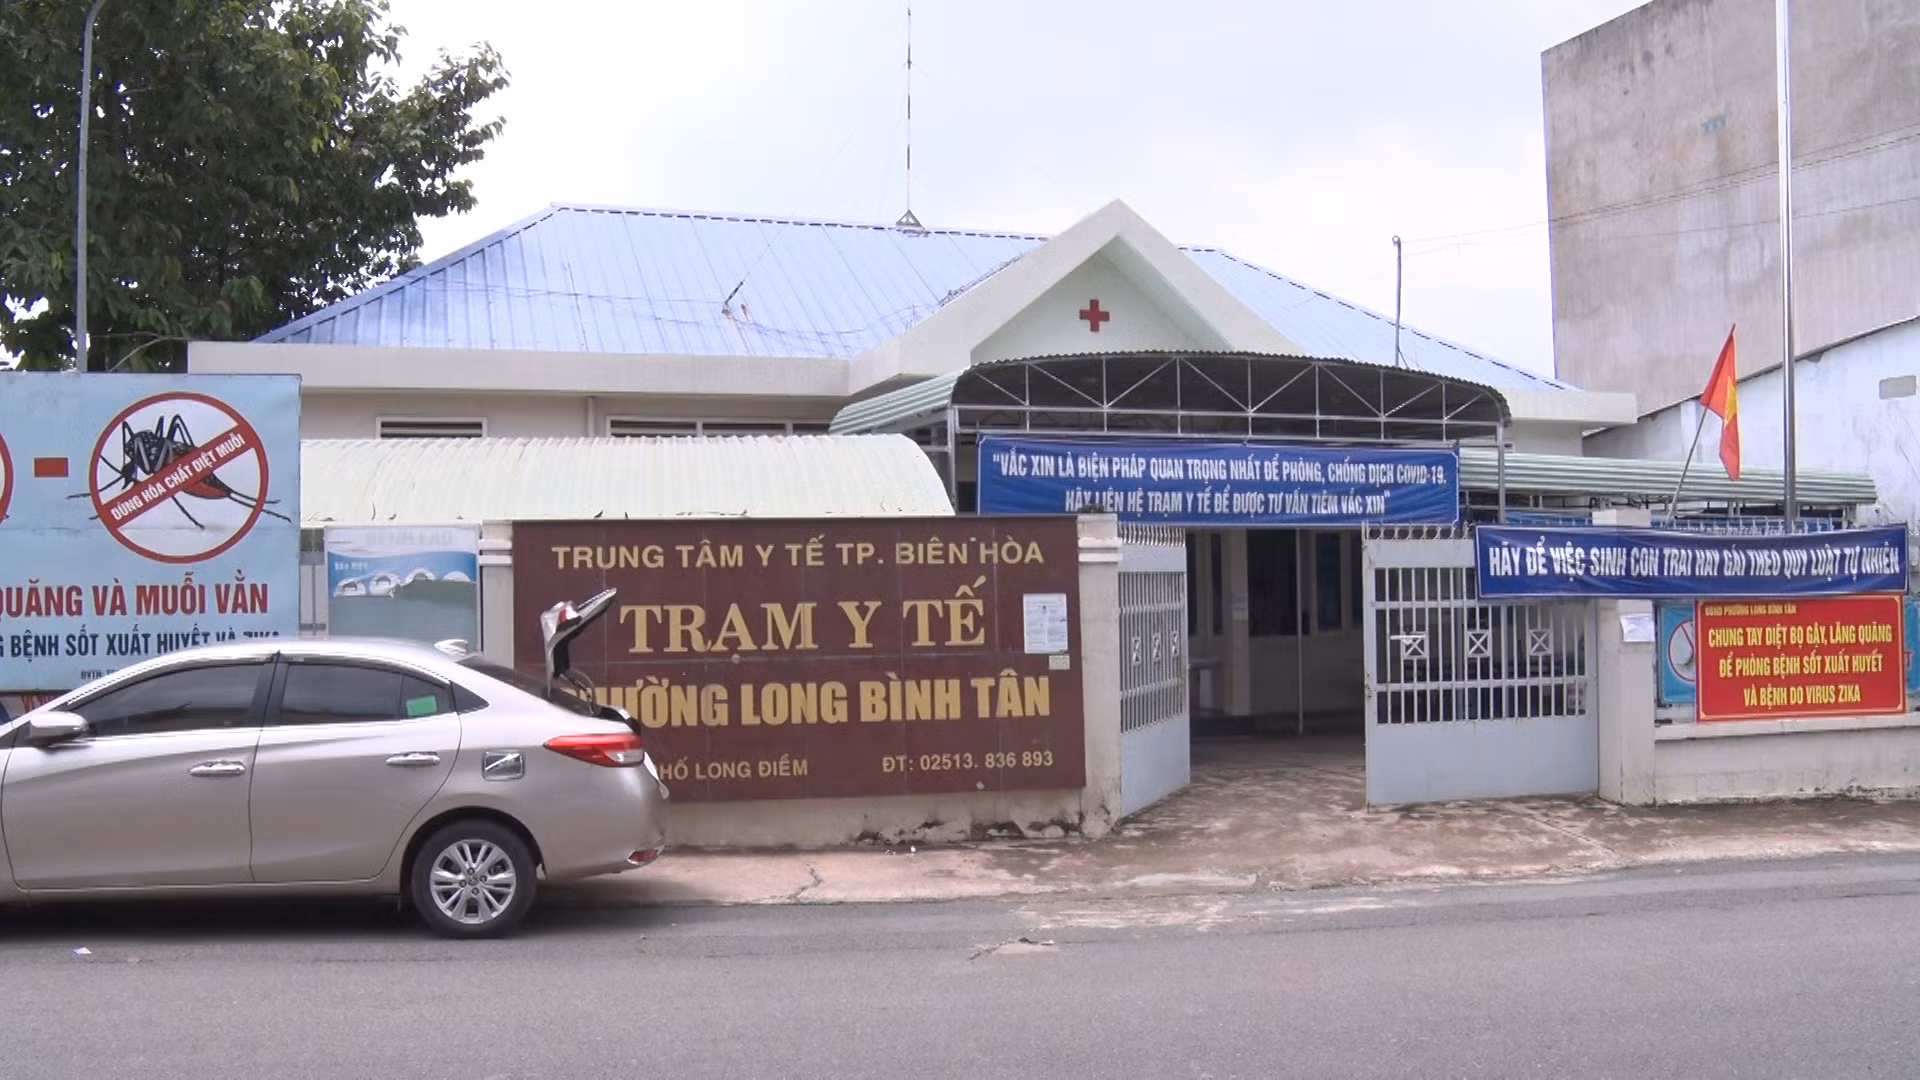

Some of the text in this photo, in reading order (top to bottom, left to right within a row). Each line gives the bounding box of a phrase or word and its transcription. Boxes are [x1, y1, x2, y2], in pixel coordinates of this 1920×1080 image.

[165, 464, 194, 488] CHẤT
[1031, 455, 1054, 477] XIN
[1058, 452, 1074, 478] LÀ
[1078, 452, 1109, 483] BIỆN
[1112, 453, 1147, 479] PHÁP
[1150, 458, 1184, 480] QUAN
[1186, 459, 1227, 483] TRỌNG
[1229, 453, 1261, 480] NHẤT
[1263, 453, 1280, 481] ĐỂ
[1282, 457, 1325, 484] PHÒNG,
[1327, 456, 1366, 483] CHỐNG
[1369, 463, 1394, 488] DỊCH
[1396, 464, 1447, 484] COVID-19.
[1127, 488, 1144, 517] HỆ
[1147, 491, 1183, 517] TRẠM
[1186, 492, 1195, 513] Y
[1196, 485, 1212, 513] TẾ
[1213, 483, 1231, 513] ĐỂ
[1232, 491, 1266, 518] ĐƯỢC
[1267, 491, 1284, 514] TƯ
[1285, 487, 1308, 514] VẤN
[1311, 489, 1338, 515] TIÊM
[551, 534, 1045, 570] TRUNG TÂM Y TẾ TP. BIÊN HÒA
[1488, 535, 1900, 582] HÃY ĐỂ VIỆC SINH CON TRAI HAY GÁI THEO QUY LUẬT TỰ NHIÊN
[0, 569, 268, 620] UĂNG VÀ MUỖI VẰN
[619, 602, 818, 664] TRẠM
[837, 600, 882, 648] Y
[902, 575, 986, 647] TẾ
[1708, 628, 1744, 648] CHUNG
[1746, 627, 1763, 646] TAY
[1765, 624, 1788, 649] DIỆT
[1790, 626, 1804, 648] BỌ
[1829, 622, 1856, 645] LĂNG
[1858, 622, 1893, 646] QUĂNG
[11, 629, 59, 662] BỆNH
[65, 624, 99, 656] SỐT
[106, 624, 151, 656] XUẤT
[1735, 653, 1771, 676] PHÒNG
[1773, 654, 1800, 680] BỆNH
[1802, 649, 1824, 675] SỐT
[1825, 648, 1850, 674] XUẤT
[1852, 648, 1883, 673] HUYẾT
[560, 668, 1050, 729] ƯỜNG LONG BÌNH TÂN
[1744, 683, 1861, 710] VÀ BỆNH DO VIRUS ZIKA
[656, 755, 689, 780] HỐ
[695, 760, 751, 780] LONG
[882, 749, 1053, 773] ĐT: 02513. 836 893
